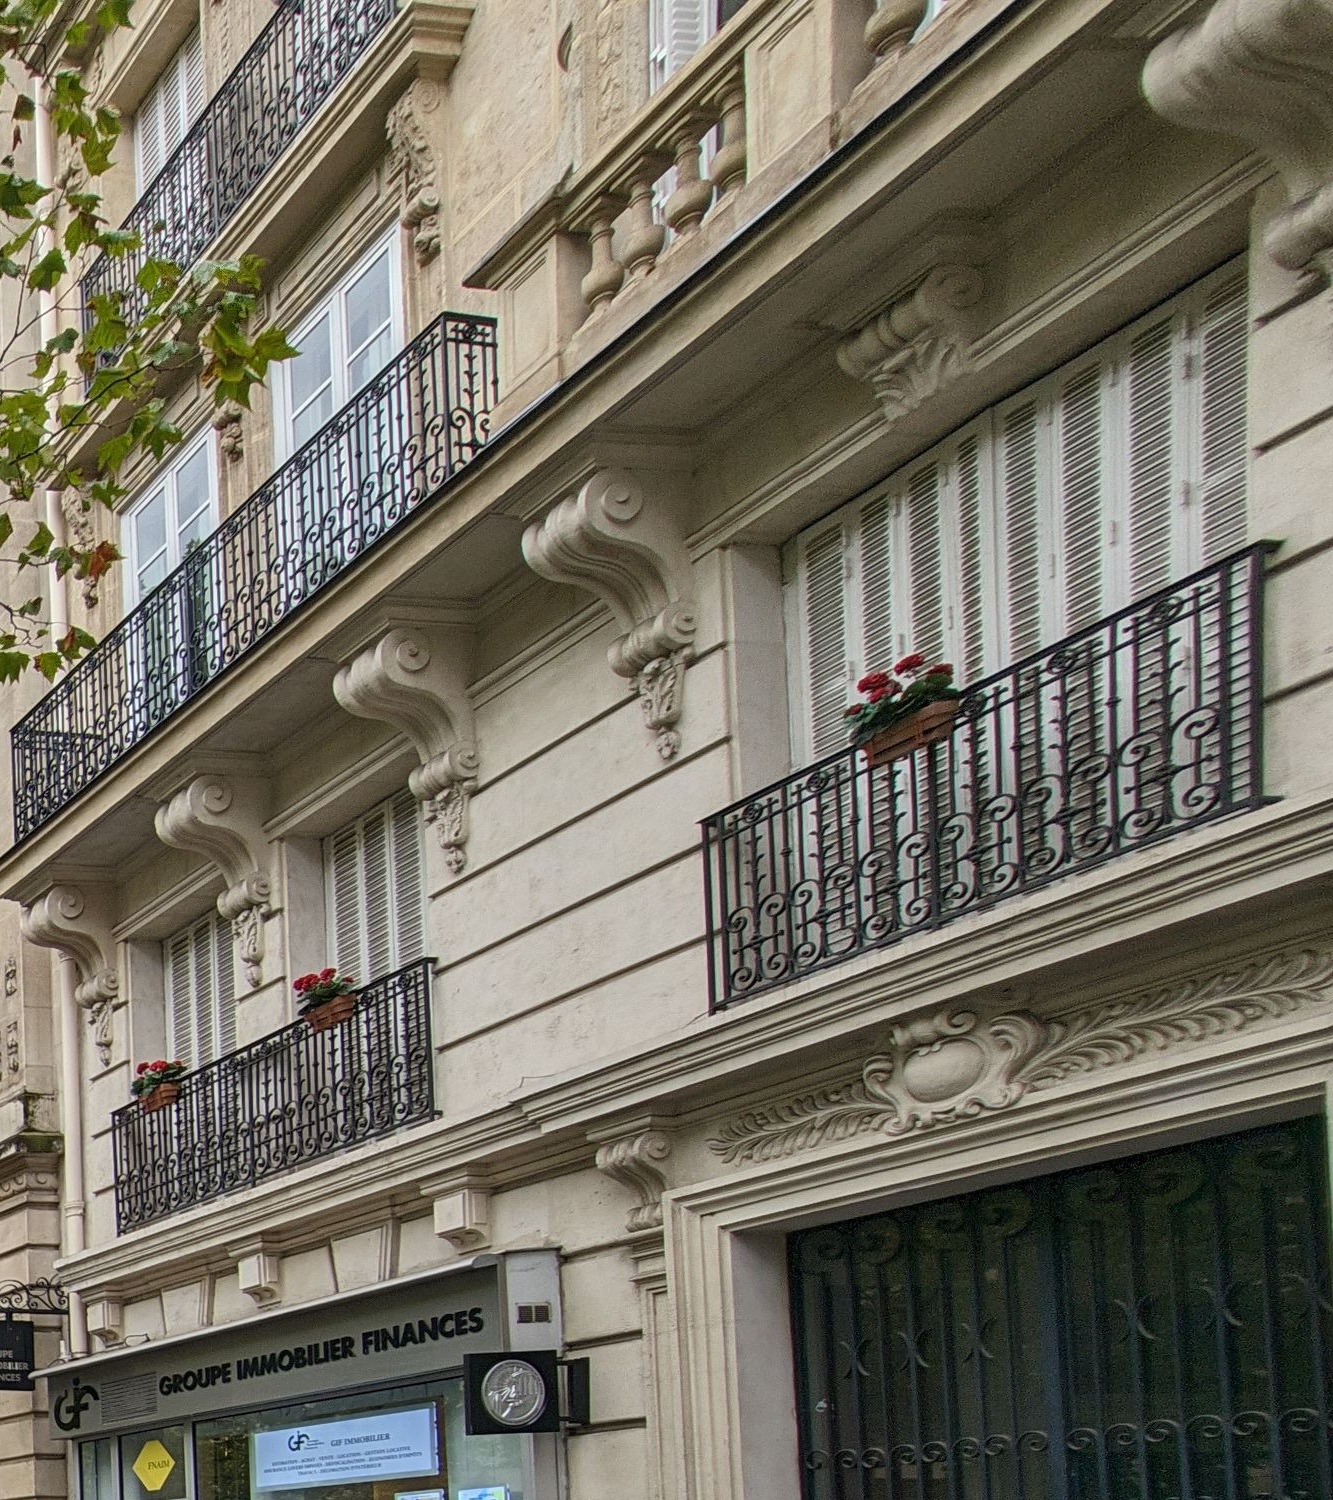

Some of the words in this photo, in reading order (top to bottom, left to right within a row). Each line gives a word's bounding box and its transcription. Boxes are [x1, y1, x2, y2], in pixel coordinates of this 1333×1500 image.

[158, 1362, 232, 1397] GROUPE
[236, 1340, 356, 1381] IMMOBILIER
[362, 1307, 484, 1355] FINANCES
[330, 1438, 342, 1447] GIF
[344, 1433, 391, 1446] IMMOBILIER
[148, 1460, 170, 1470] FNAIM
